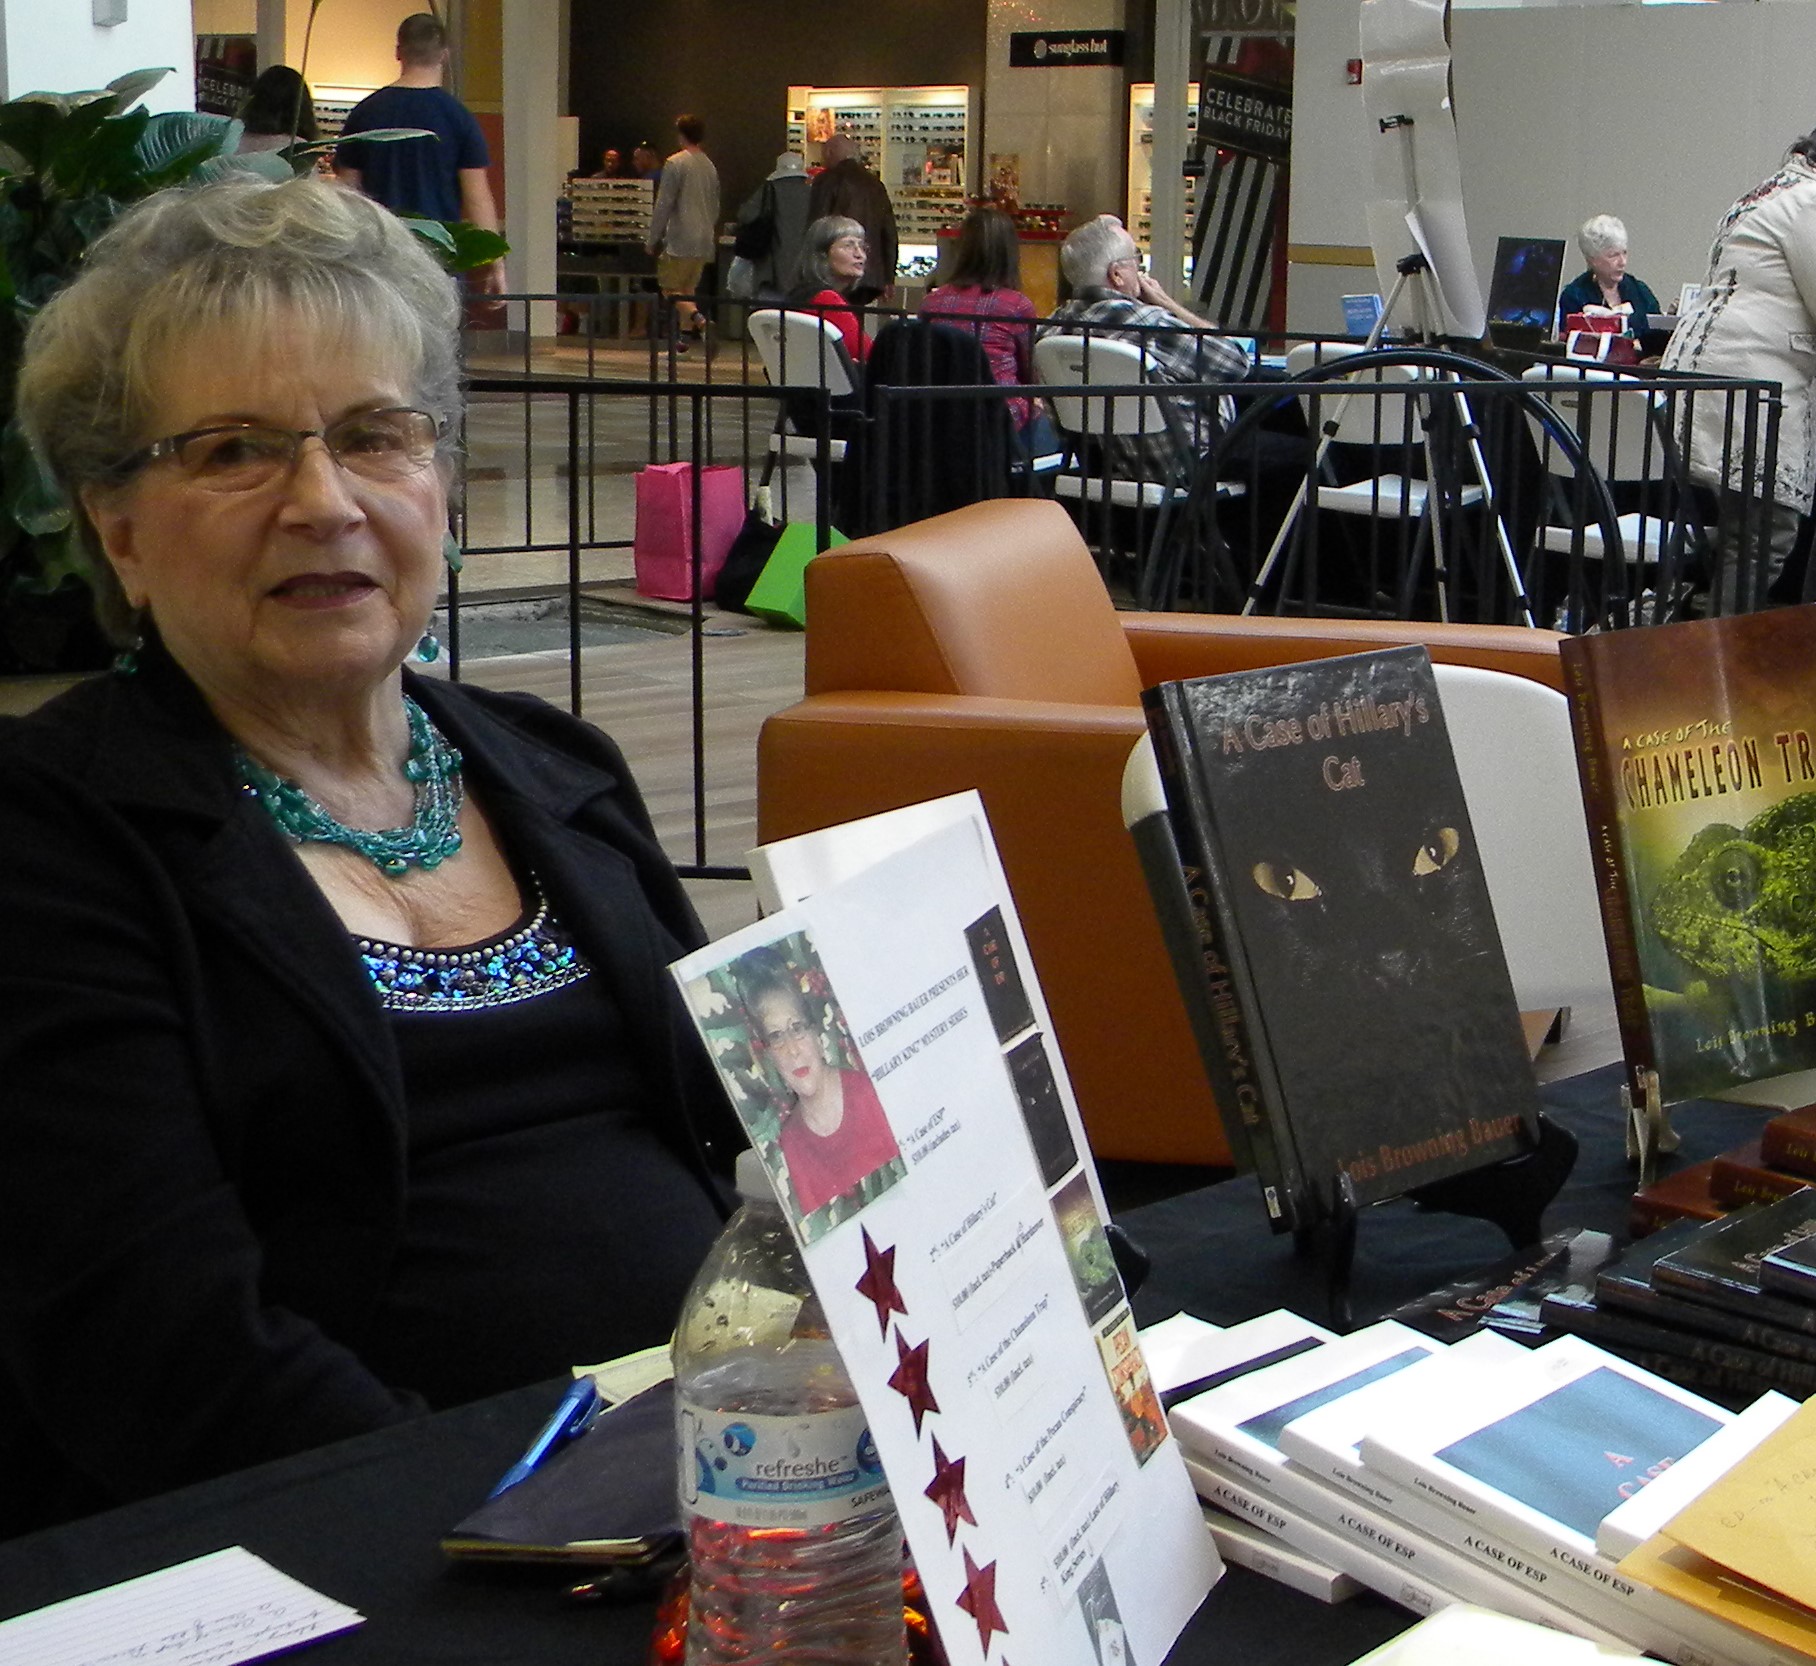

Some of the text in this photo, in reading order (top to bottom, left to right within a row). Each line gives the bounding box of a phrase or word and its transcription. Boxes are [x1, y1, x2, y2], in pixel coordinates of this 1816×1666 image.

[1090, 38, 1107, 52] hut
[1203, 106, 1290, 140] BLACK FRIDAY
[1206, 88, 1292, 126] CELEBRATE
[1222, 726, 1243, 755] A
[1244, 714, 1302, 752] Case
[1307, 703, 1332, 740] of
[1333, 691, 1430, 737] Hillary's
[1622, 719, 1732, 750] A CASE OF THE
[1322, 755, 1366, 792] Cat
[1621, 736, 1763, 811] CHAMELEON
[1190, 886, 1213, 944] Case
[1203, 950, 1226, 981] of
[1235, 1082, 1260, 1126] Cat
[1695, 1031, 1725, 1053] Lois
[1727, 1017, 1799, 1051] Browning
[1379, 1129, 1468, 1176] Browning
[1469, 1114, 1522, 1146] Bauer
[756, 1457, 839, 1478] refreshe
[1603, 1451, 1635, 1469] A
[1214, 1486, 1287, 1530] A CASE OF ESP
[1337, 1513, 1417, 1561] A CASE OF ESP
[1464, 1535, 1547, 1584] A CASE OF ESP
[1550, 1547, 1635, 1598] A CASE OF ESP
